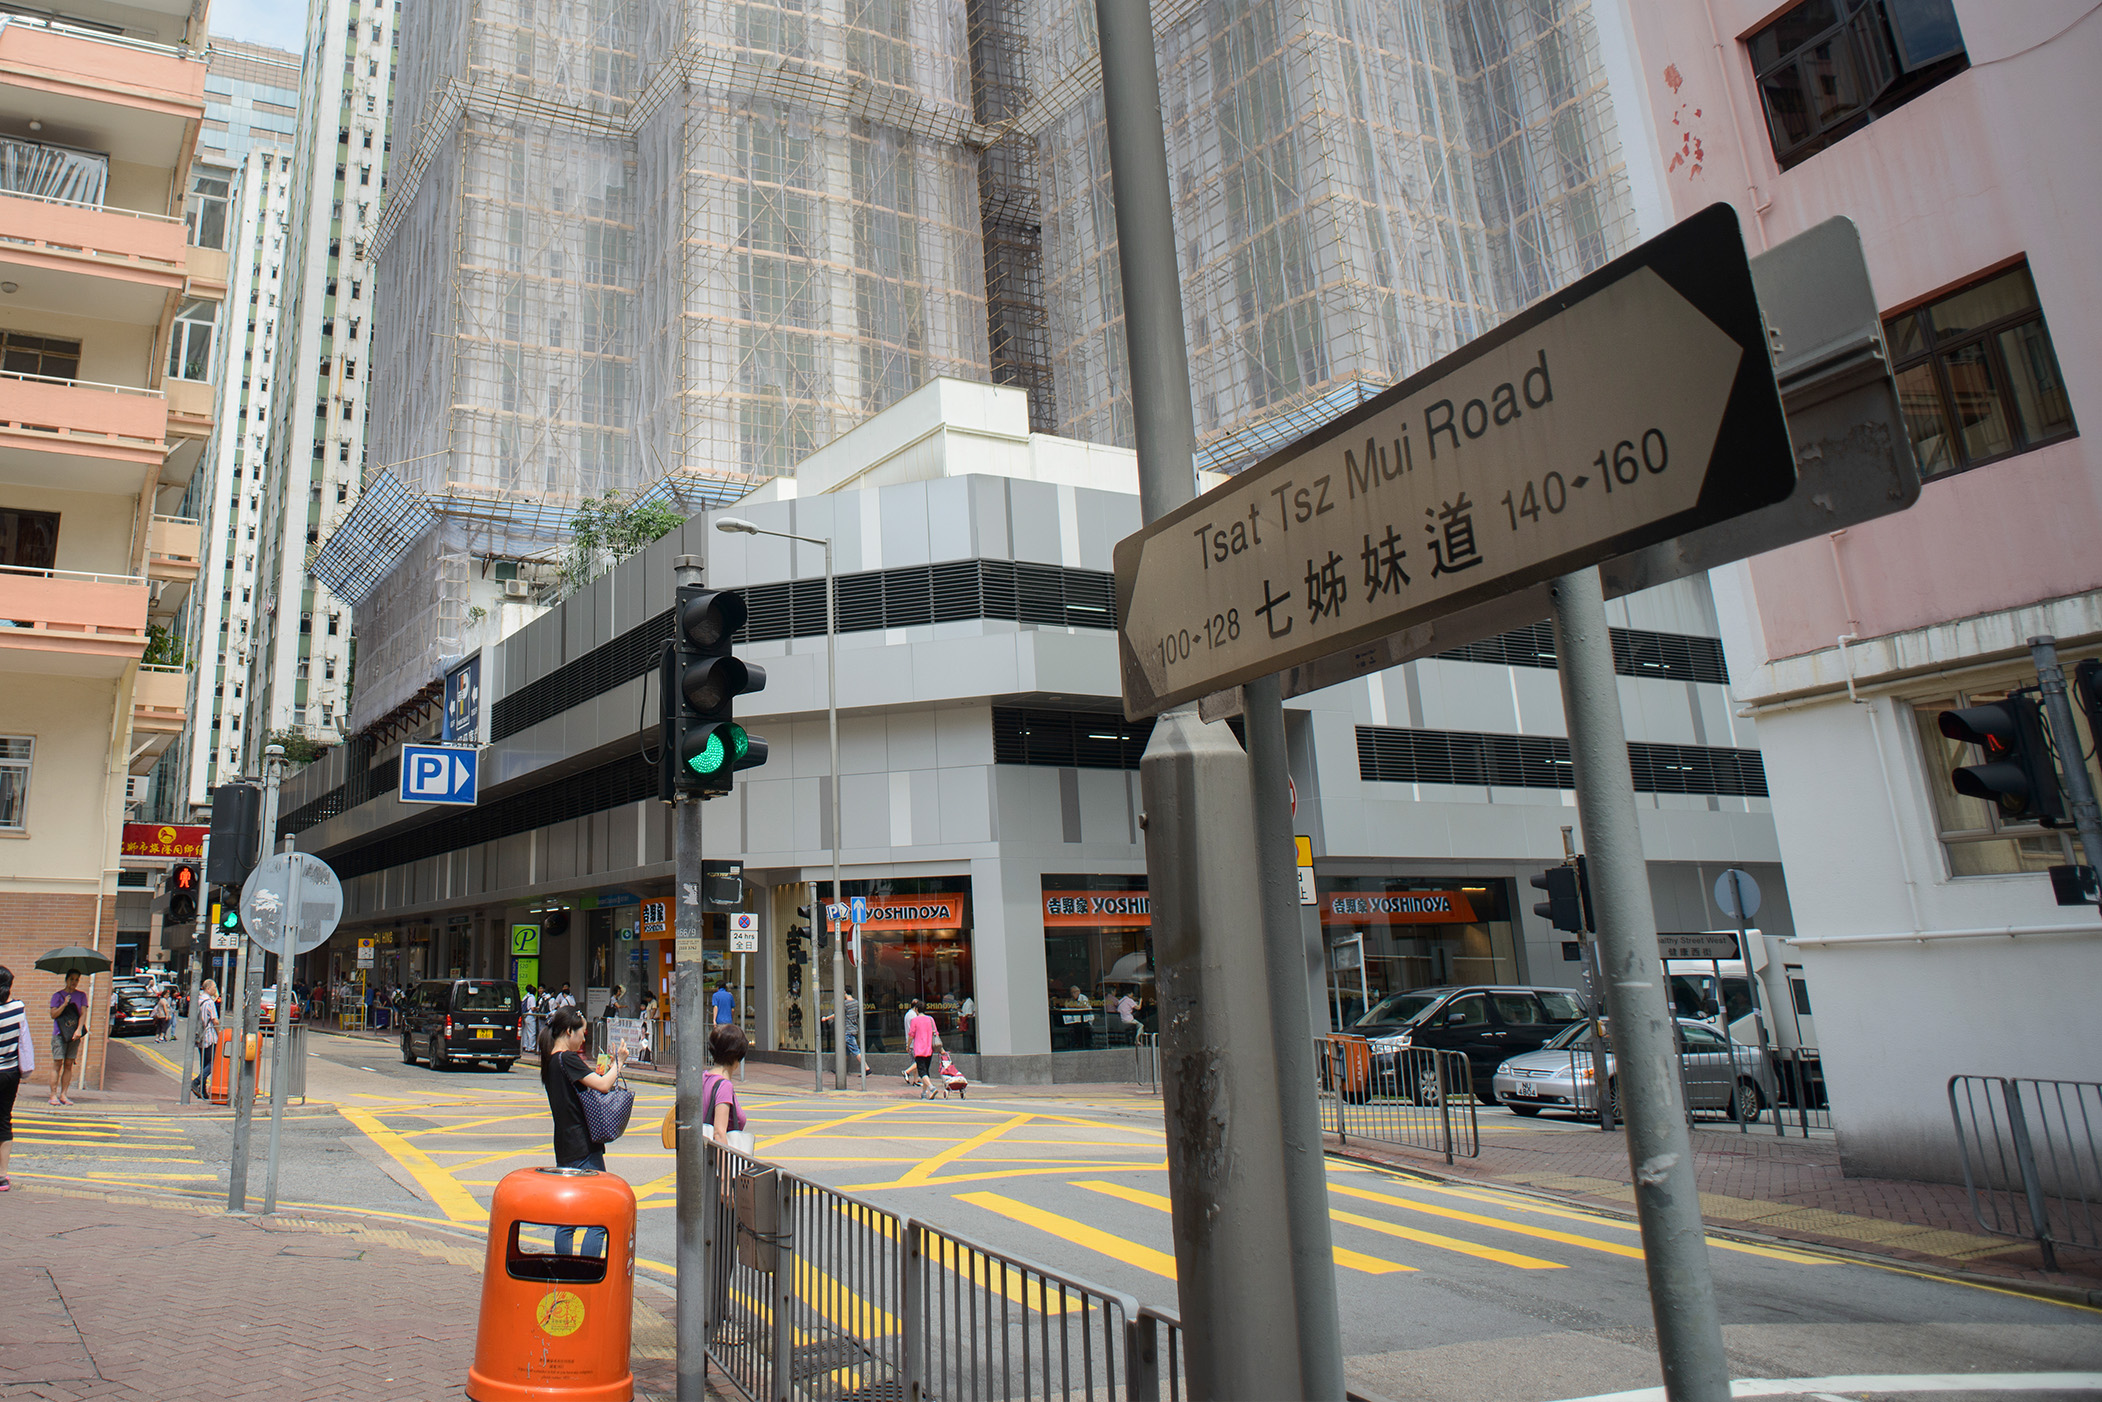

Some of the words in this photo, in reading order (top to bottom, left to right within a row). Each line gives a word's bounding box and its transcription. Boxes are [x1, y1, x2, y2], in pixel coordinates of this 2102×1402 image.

[1193, 503, 1262, 569] Tsat
[1271, 473, 1335, 532] Tsz
[1344, 422, 1413, 501] Mui
[1423, 348, 1554, 461] Road
[1254, 491, 1484, 640] 七姊妹道
[416, 756, 443, 790] P
[1369, 896, 1453, 914] YOSHINOYA
[217, 936, 237, 947] 全日
[733, 932, 743, 940] 24
[744, 932, 755, 940] hrs
[1680, 937, 1705, 945] Street
[1706, 937, 1727, 945] West
[736, 941, 753, 950] 全日
